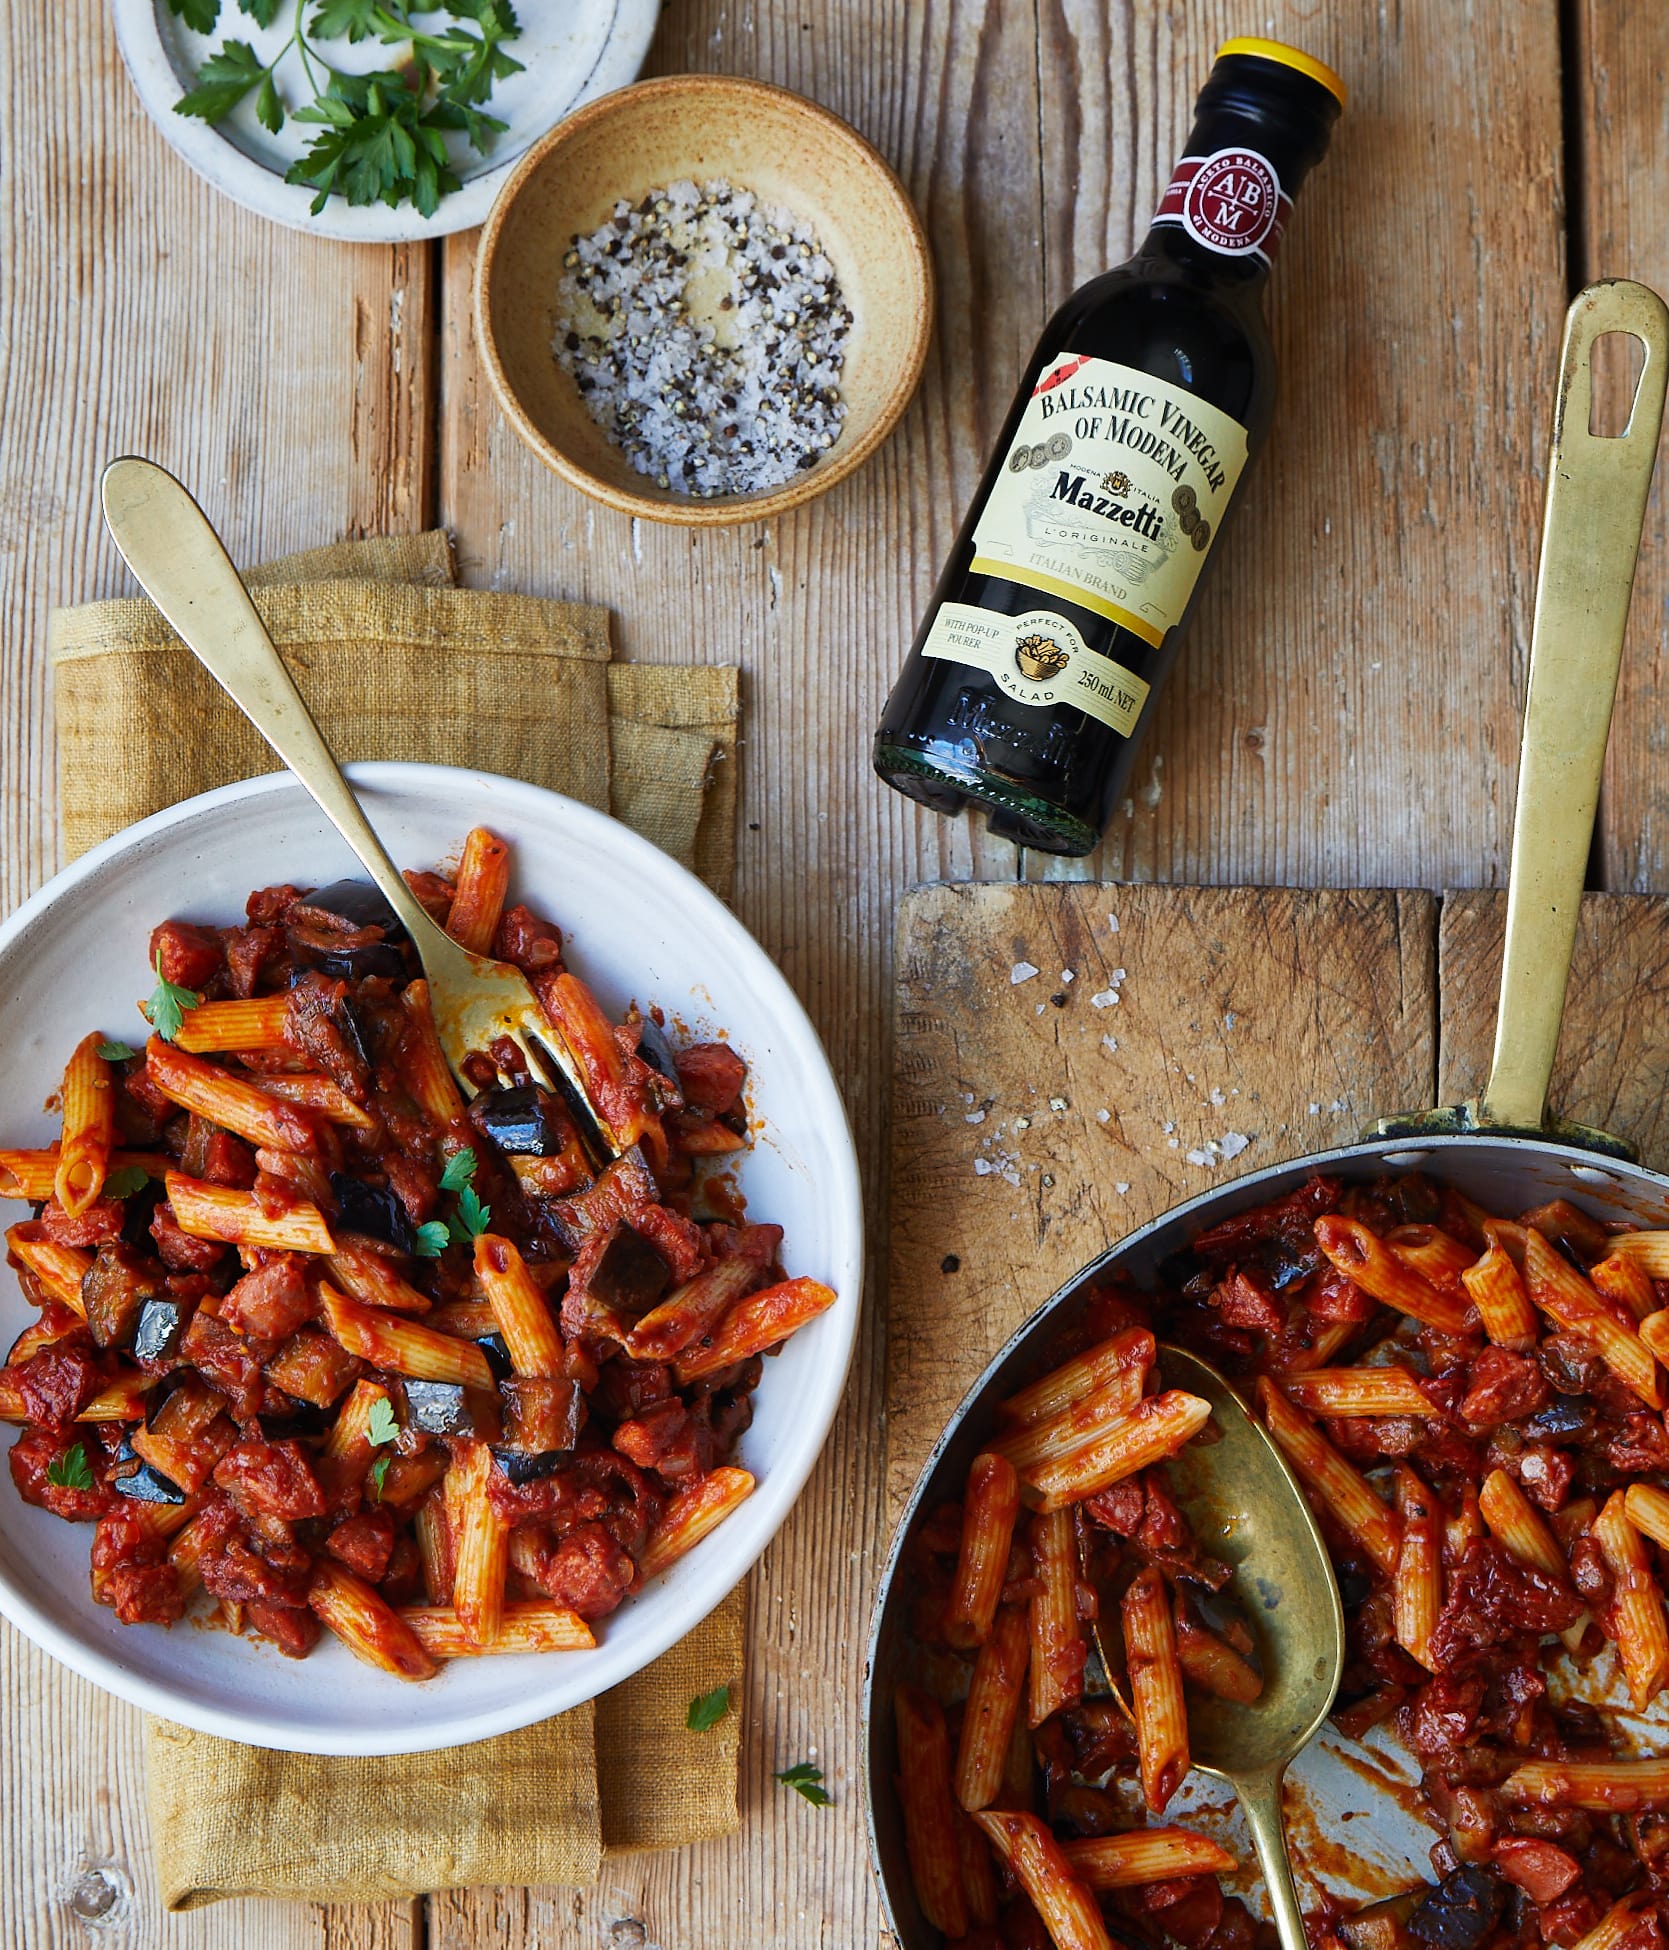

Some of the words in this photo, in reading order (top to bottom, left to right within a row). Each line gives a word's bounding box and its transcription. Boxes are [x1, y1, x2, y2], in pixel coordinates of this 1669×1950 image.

[1197, 158, 1231, 190] ACETO
[1236, 157, 1274, 218] BALSAMICO
[1213, 173, 1235, 196] A
[1241, 181, 1262, 206] B
[1214, 201, 1244, 231] M
[1201, 228, 1251, 247] MODENA
[1040, 385, 1155, 420] BALSAMIC
[1160, 399, 1226, 494] VINEGAR
[1075, 416, 1103, 440] OF
[1104, 415, 1189, 483] MODENA
[1070, 463, 1102, 478] MODENA
[1049, 470, 1164, 542] Mazzetti
[1044, 527, 1150, 553] L'ORIGINALE
[1029, 552, 1082, 581] ITALIAN
[1083, 570, 1129, 601] BRAND
[944, 618, 967, 632] WITH
[966, 623, 1001, 640] POP-UP
[947, 633, 982, 650] POURER
[1016, 618, 1065, 632] PERFECT
[1066, 632, 1080, 654] FOR
[1000, 673, 1055, 701] SALAD
[1077, 670, 1099, 692] 250
[1097, 682, 1114, 702] mL
[1114, 690, 1137, 714] NET
